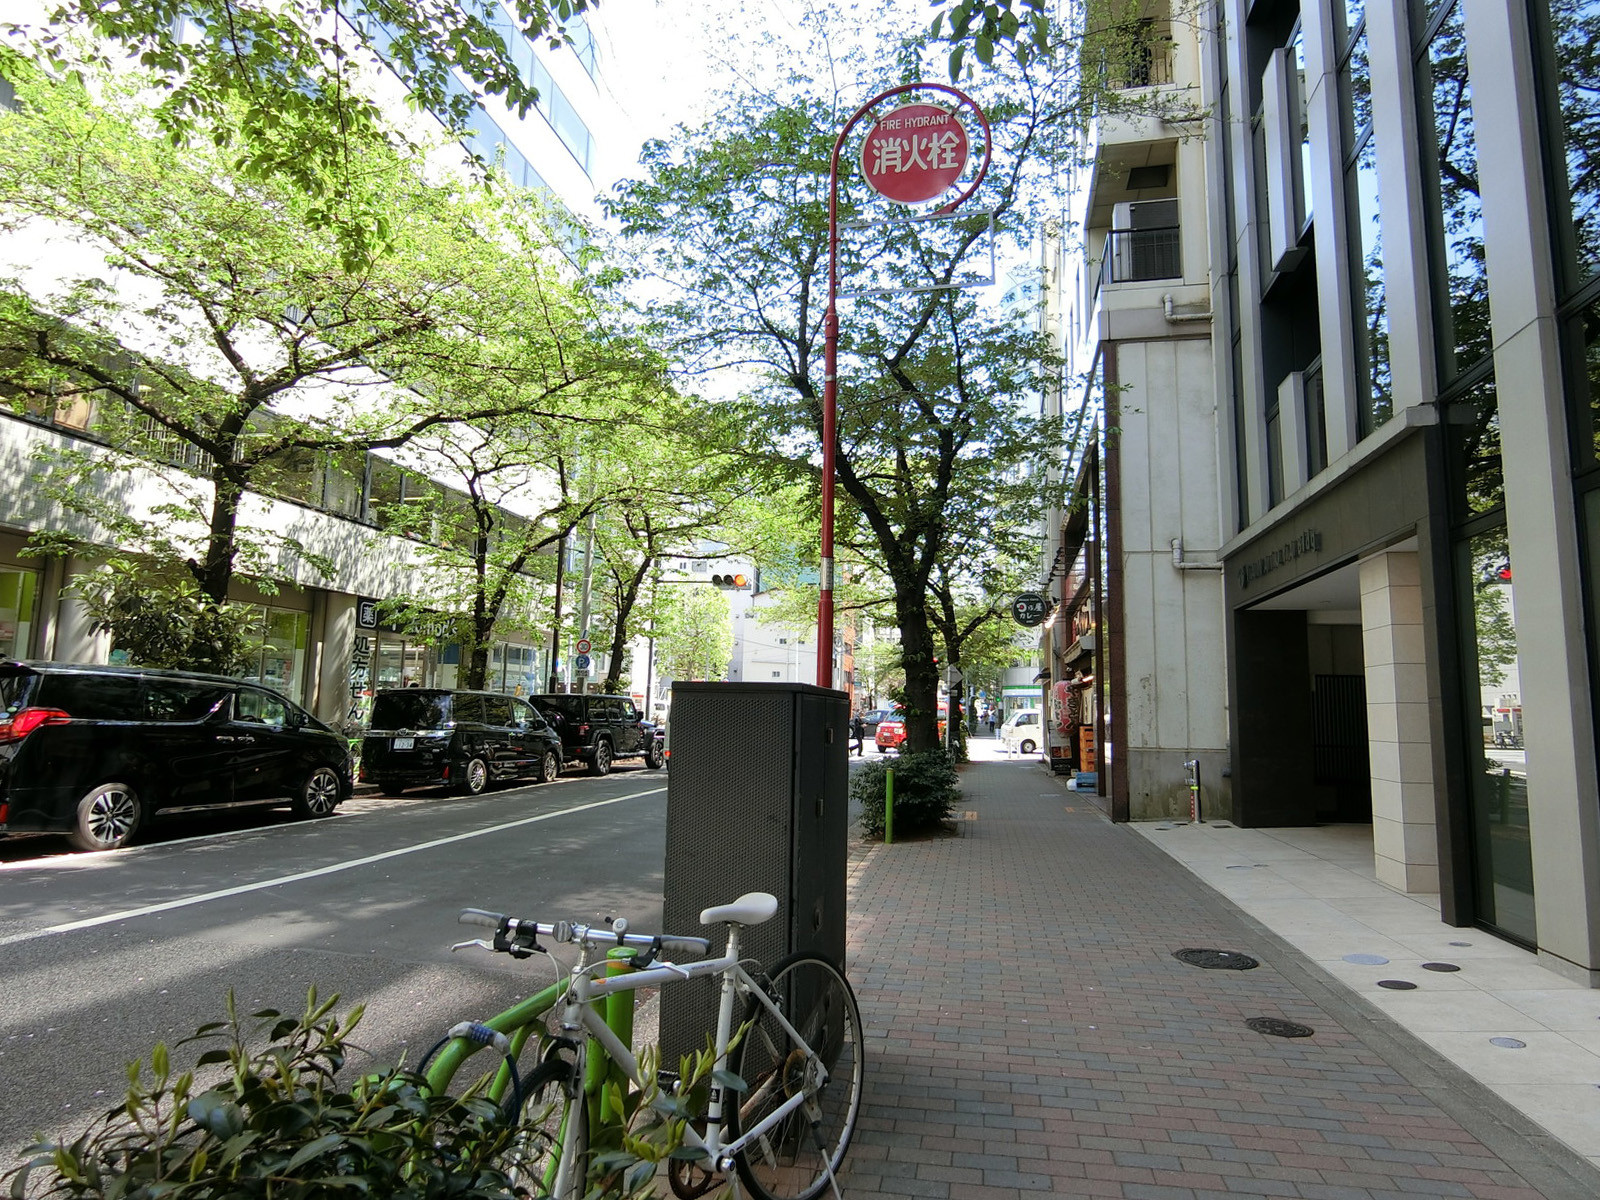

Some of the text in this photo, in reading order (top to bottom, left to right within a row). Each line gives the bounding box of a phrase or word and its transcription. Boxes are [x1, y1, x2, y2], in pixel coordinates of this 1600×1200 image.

[880, 114, 950, 131] FIRE HYDRANT
[872, 130, 960, 176] 消火栓
[362, 604, 375, 624] 薬
[347, 635, 369, 720] 処方せん
